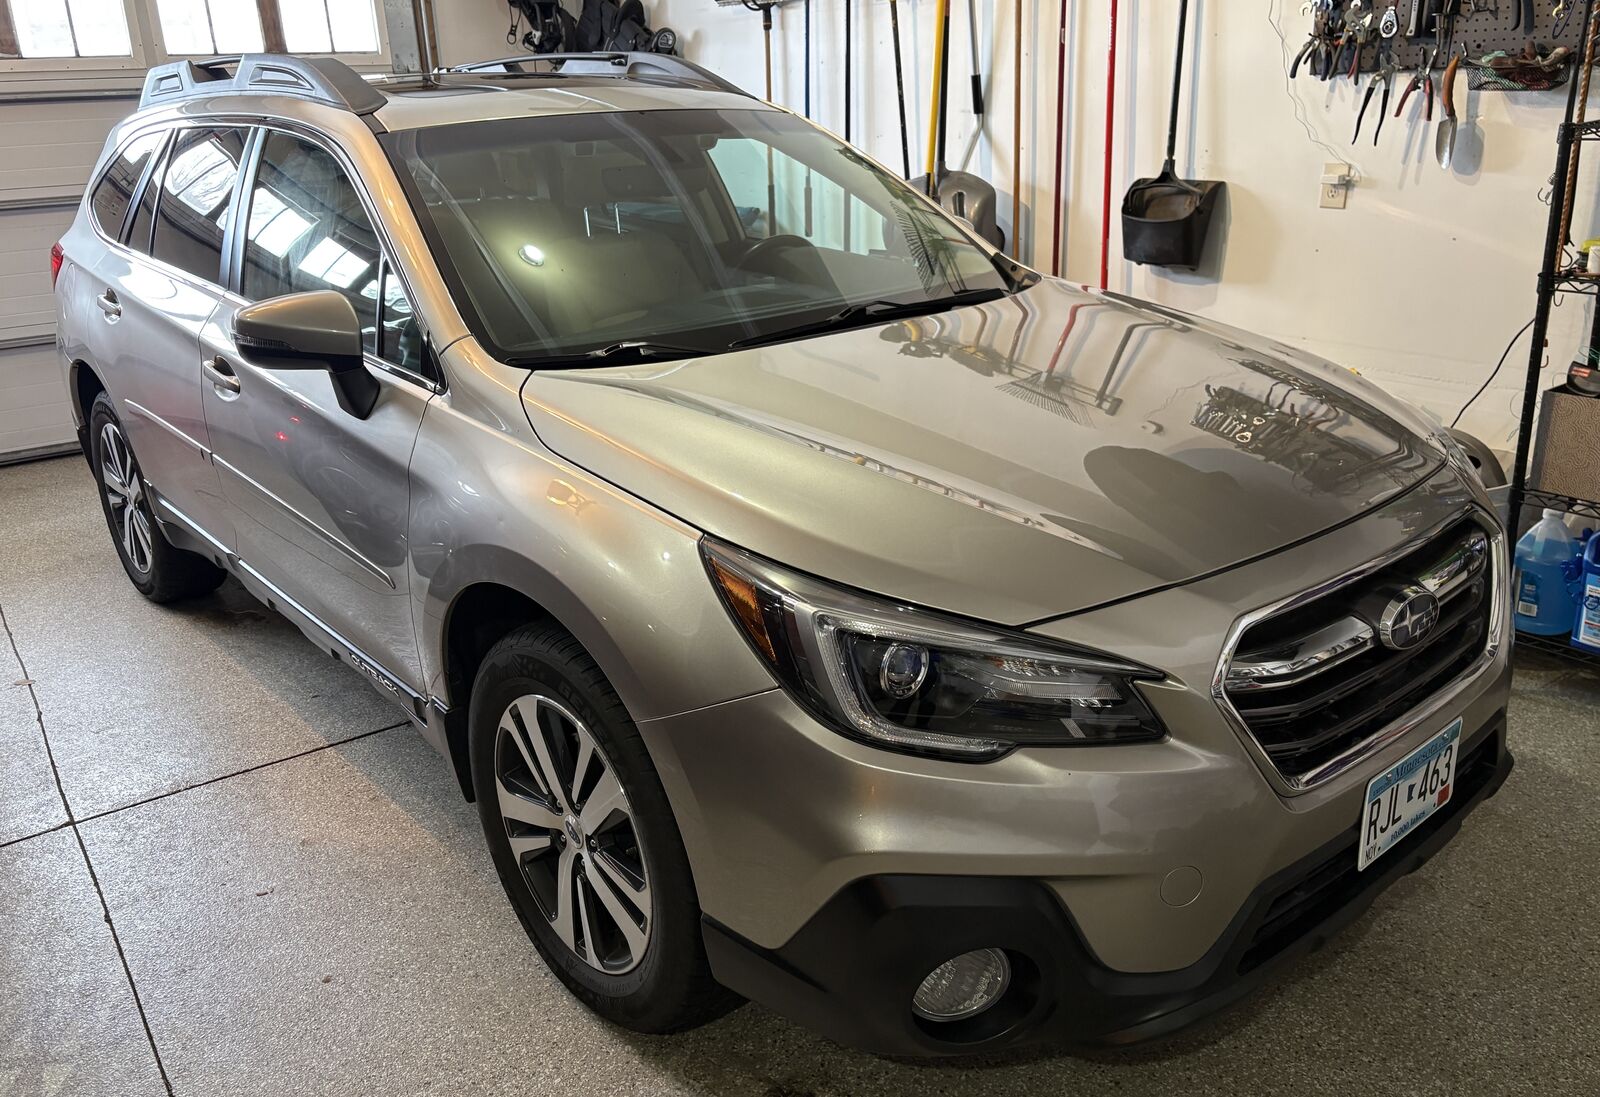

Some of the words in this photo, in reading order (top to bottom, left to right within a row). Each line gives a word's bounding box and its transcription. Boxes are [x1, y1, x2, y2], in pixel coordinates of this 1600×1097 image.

[351, 654, 399, 697] OUTBACK
[1366, 783, 1401, 846] RJL
[1417, 744, 1453, 802] 463
